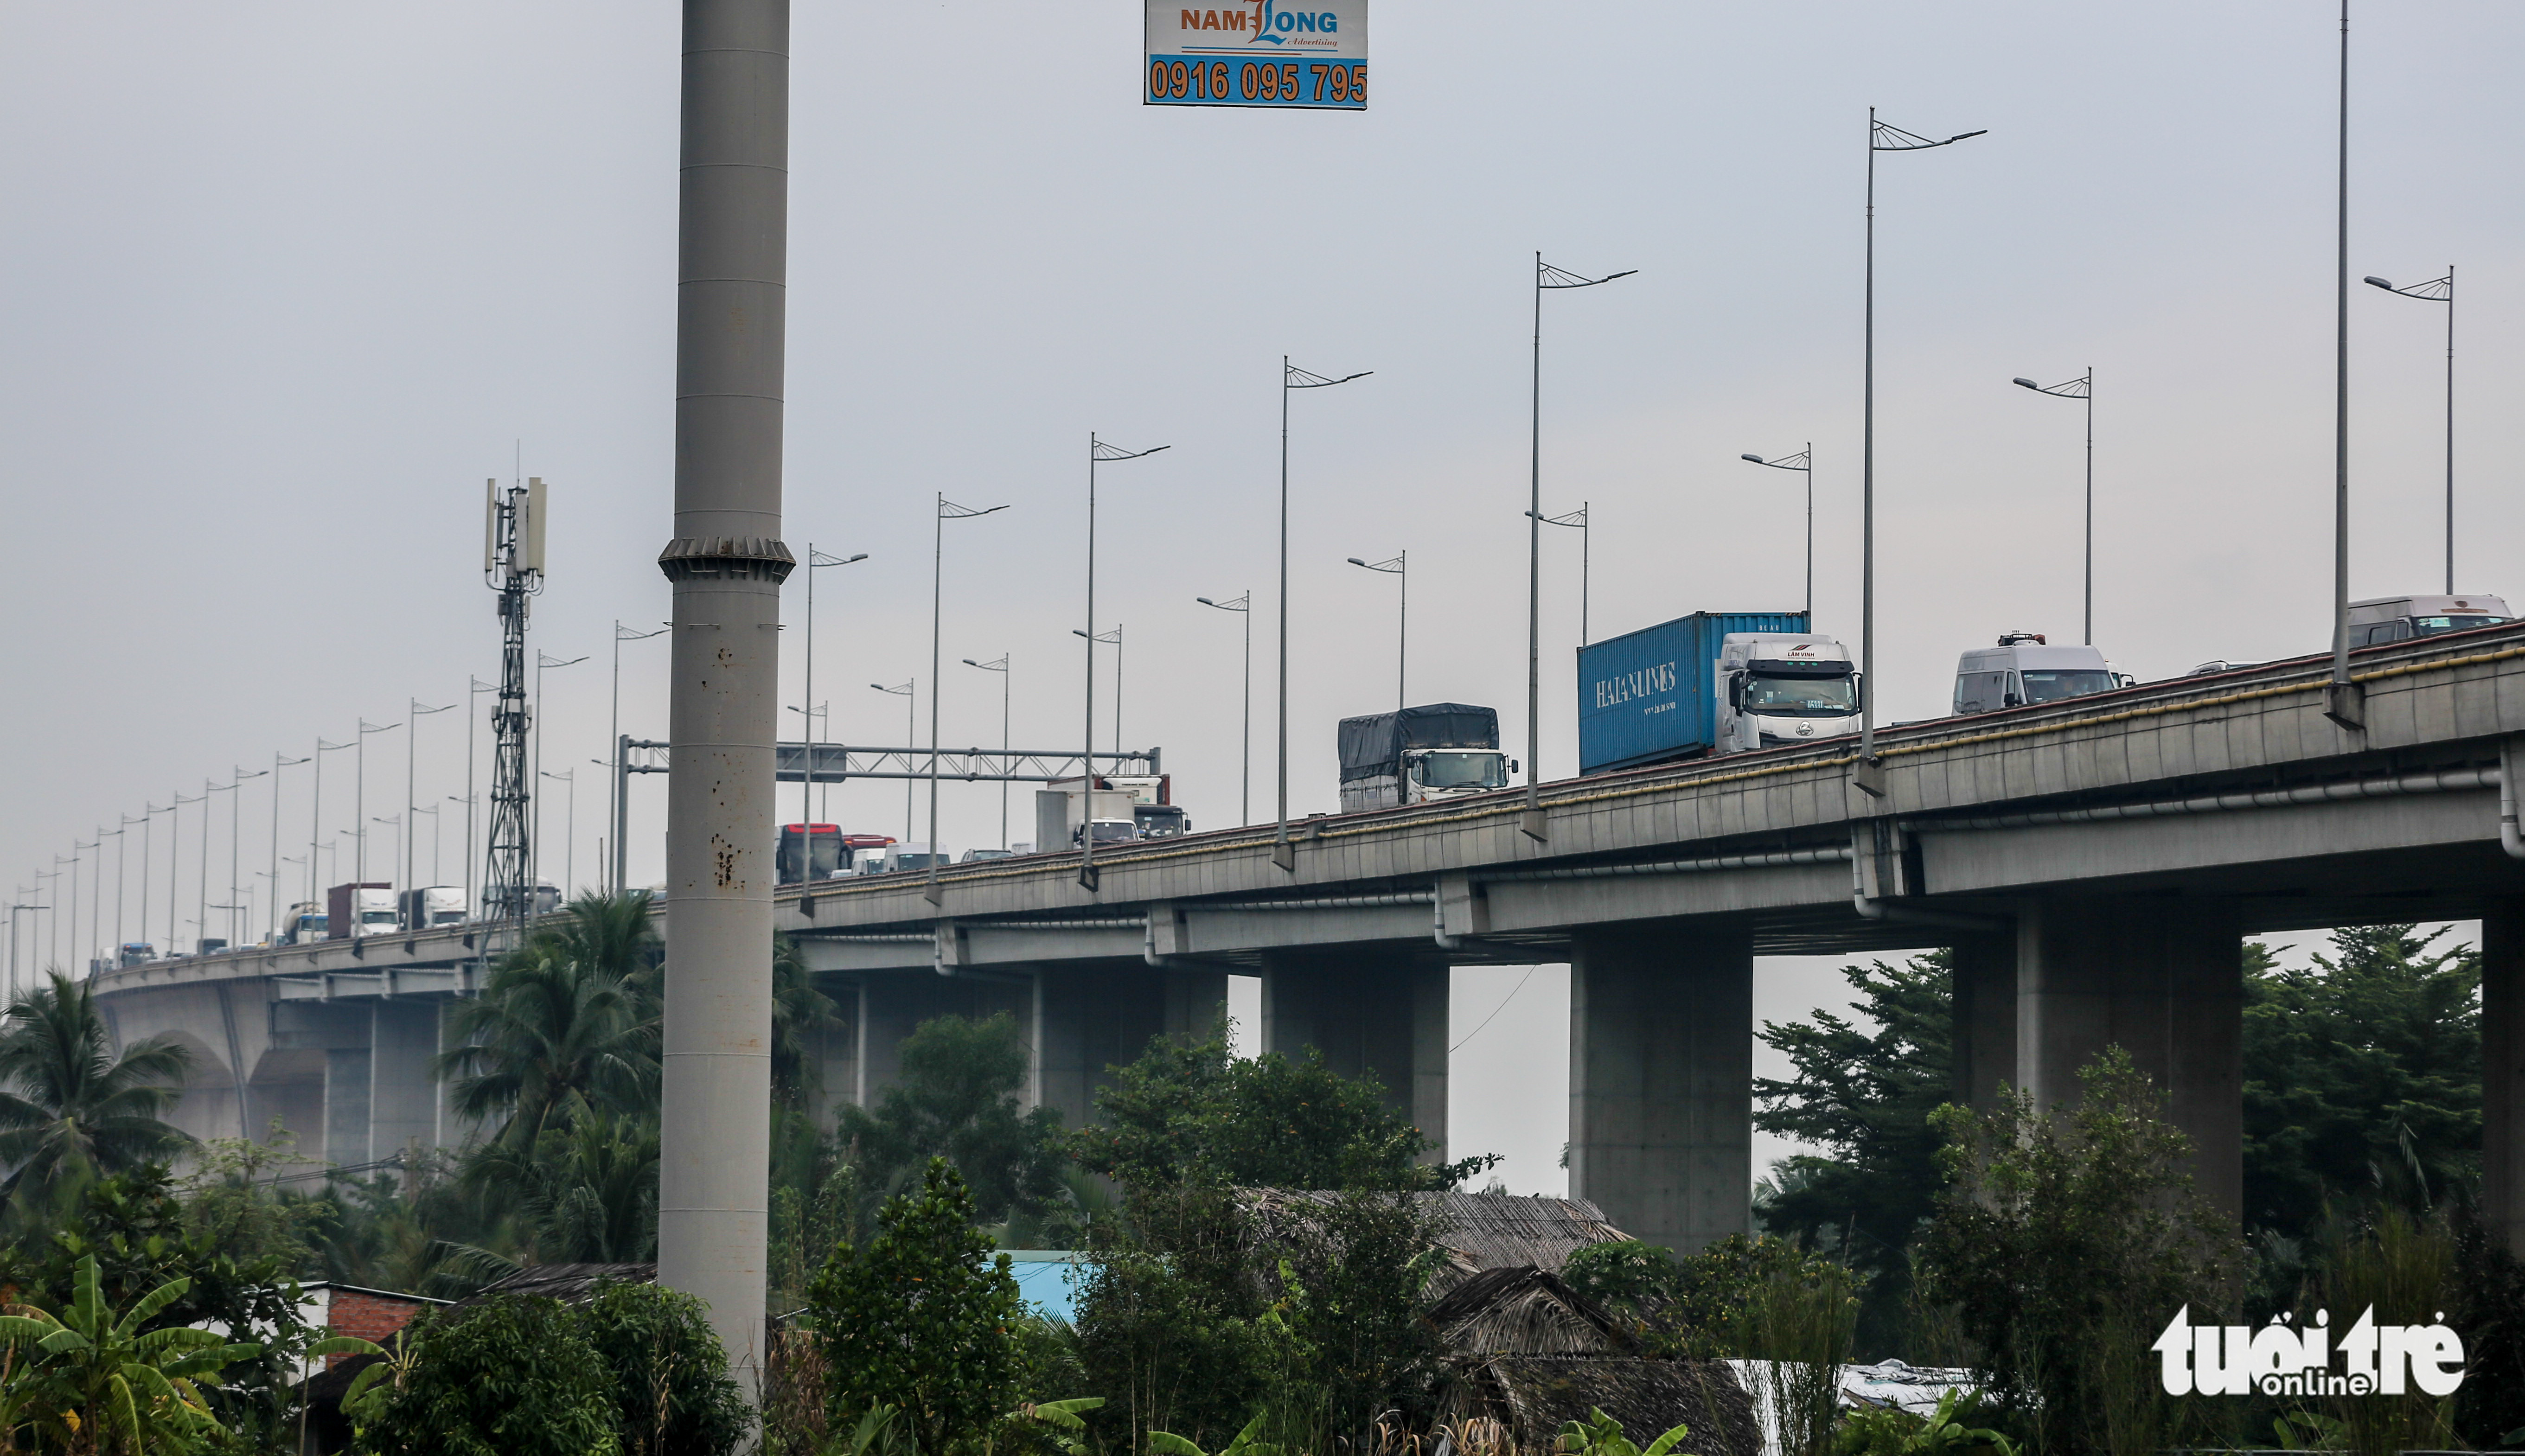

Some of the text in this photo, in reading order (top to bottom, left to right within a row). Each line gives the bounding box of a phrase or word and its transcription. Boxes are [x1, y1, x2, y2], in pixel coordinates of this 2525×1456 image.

[1181, 0, 1338, 45] NAM LONG
[1287, 38, 1338, 47] Advertising
[1150, 60, 1367, 102] 0916 095 795
